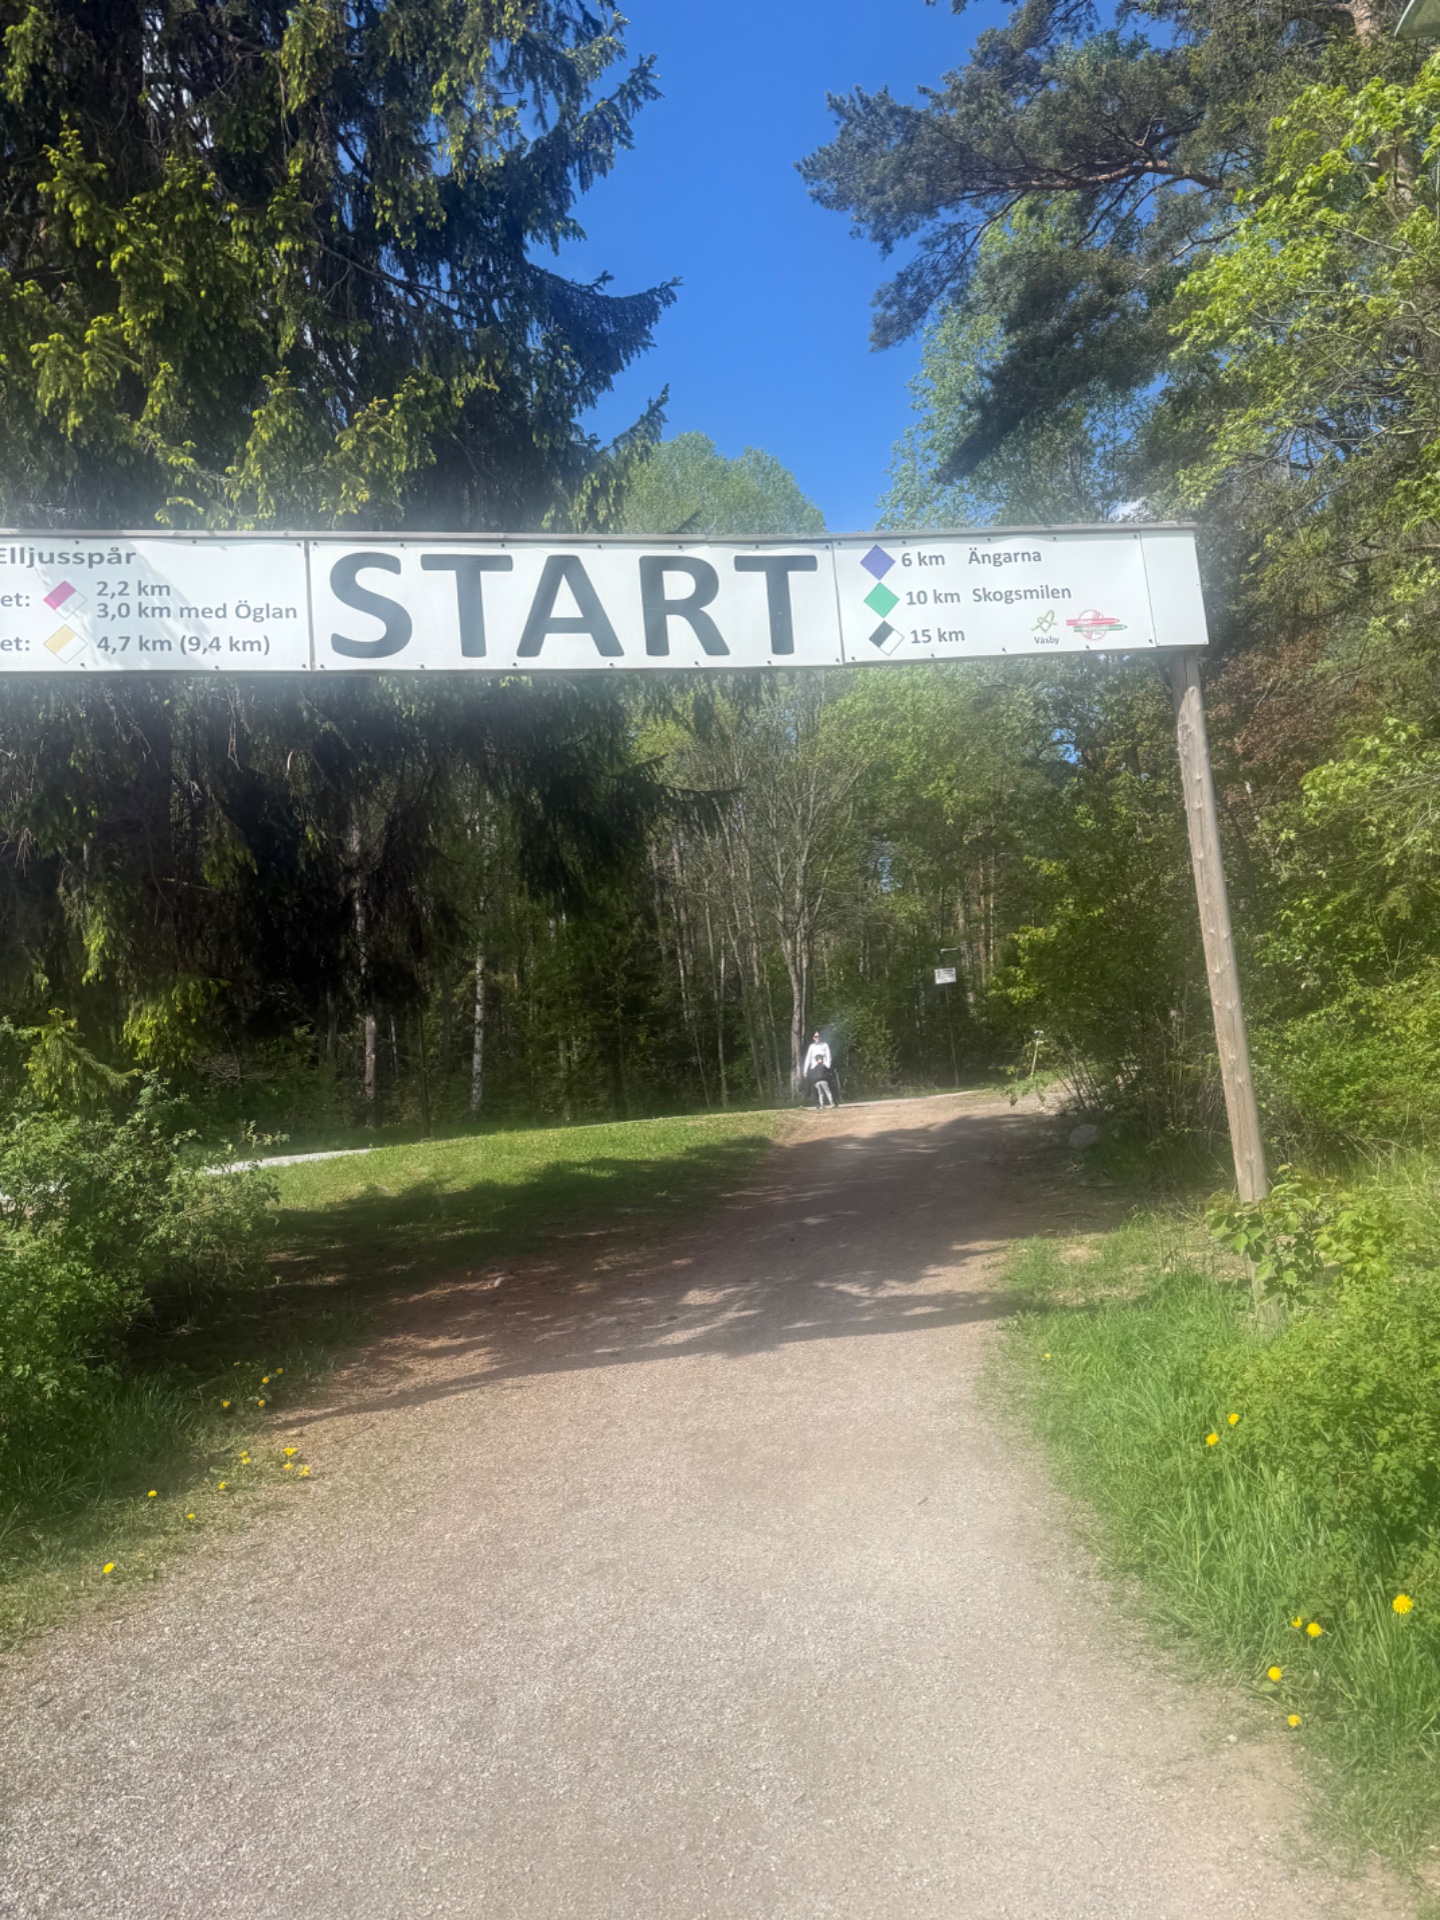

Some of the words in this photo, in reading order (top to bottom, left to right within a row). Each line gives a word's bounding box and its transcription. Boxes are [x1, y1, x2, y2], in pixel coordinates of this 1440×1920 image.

[901, 553, 912, 568] 6
[917, 551, 946, 567] km
[968, 547, 1042, 568] Ängarna
[96, 580, 130, 599] 2,2
[137, 579, 171, 597] km
[905, 590, 928, 606] 10
[933, 588, 961, 604] km
[972, 585, 1072, 604] Skogsmilen
[96, 602, 131, 621] 3,0
[138, 601, 171, 619] km
[179, 602, 227, 619] med
[235, 600, 298, 623] Öglan
[329, 551, 818, 659] START
[96, 635, 131, 655] 4,7
[139, 635, 172, 652] km
[180, 635, 222, 655] (9,4
[229, 635, 270, 655] km)
[910, 629, 931, 644] 15
[938, 627, 965, 643] km
